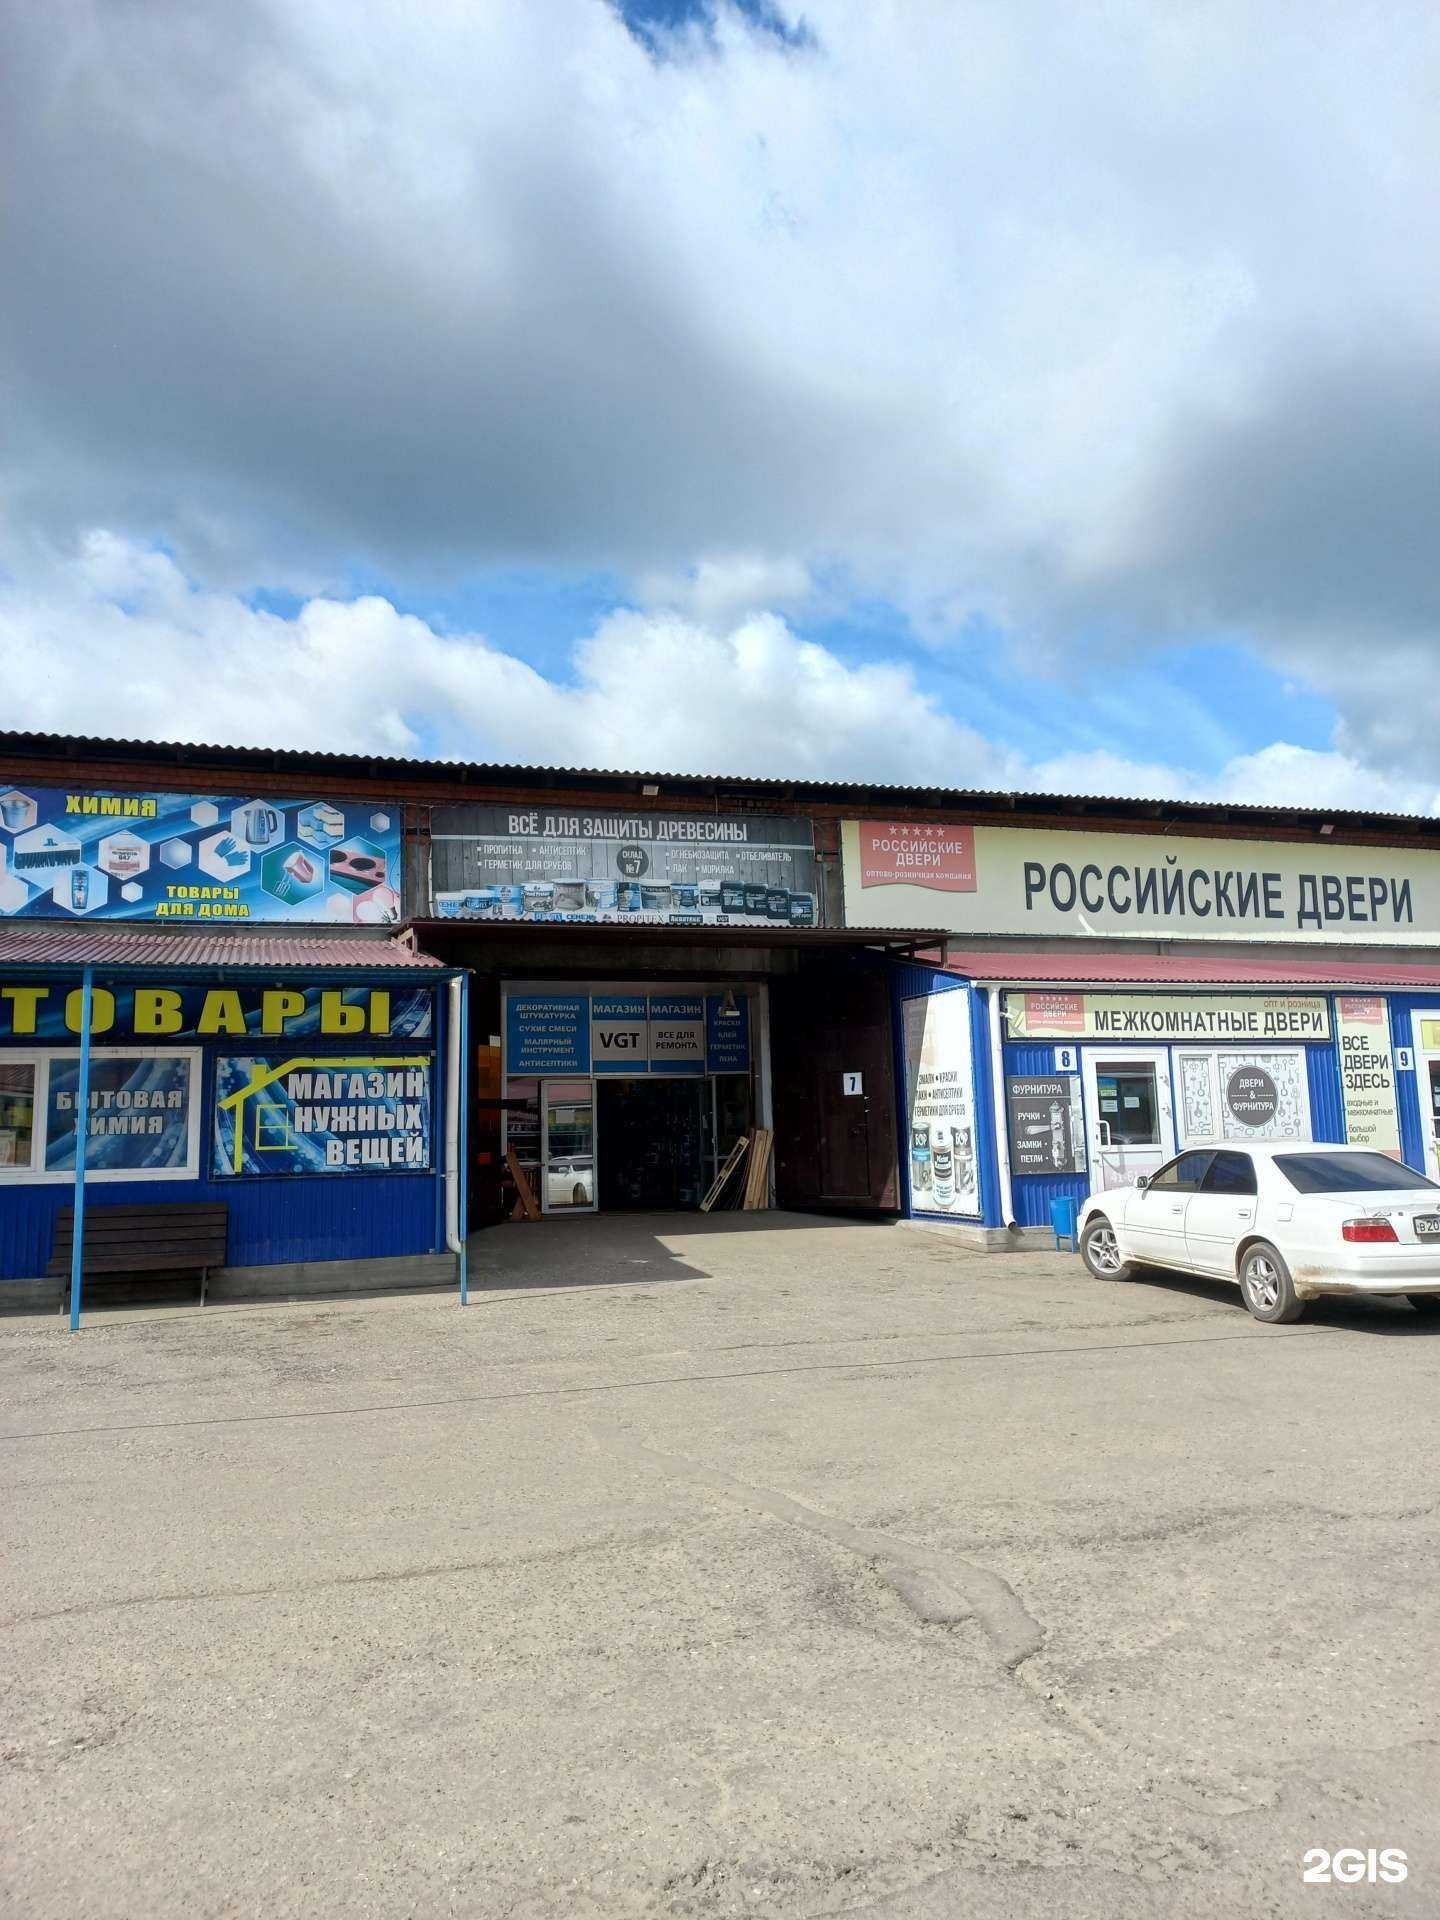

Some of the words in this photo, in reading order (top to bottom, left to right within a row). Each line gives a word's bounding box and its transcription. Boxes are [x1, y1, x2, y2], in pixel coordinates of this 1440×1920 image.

[65, 795, 157, 817] ХИМИЯ
[508, 812, 539, 835] ВСЁ
[542, 816, 580, 837] ДЛЯ
[583, 818, 653, 838] ЗАЩИТЫ
[656, 820, 748, 841] ДРЕВЕСИНЫ
[483, 844, 523, 855] ПРОПИТКА
[539, 845, 586, 856] АНТИСЕПТИК
[872, 838, 963, 854] РОССИЙСКИЕ
[622, 850, 643, 859] СКЛАД
[671, 850, 729, 860] ОГНЕБИОЗАЩИТА
[741, 851, 792, 862] ОТБЕЛИВАТЕЛЬ
[896, 852, 941, 867] ДВЕРИ
[484, 859, 523, 870] ГЕРМЕТИК
[524, 860, 542, 870] ДЛЯ
[543, 860, 571, 870] СРУБОВ
[673, 863, 688, 873] ЛАК
[166, 885, 240, 900] ТОВАРЫ
[1023, 855, 1285, 918] РОССИЙСКИЕ
[1297, 873, 1414, 929] ДВЕРИ
[155, 902, 195, 916] ДЛЯ
[197, 903, 250, 917] ДОМА
[1, 987, 391, 1034] ТОВАРЫ
[515, 1004, 580, 1012] ДЕКОРАТИВНАЯ
[593, 1004, 646, 1014] МАГАЗИН
[650, 1005, 702, 1014] МАГАЗИН
[1031, 1001, 1079, 1011] РОССИЙСКИЕ
[1264, 1000, 1277, 1009] опт
[1280, 1001, 1286, 1009] и
[1288, 1001, 1321, 1010] розница
[519, 1012, 577, 1020] ШТУКАТУРКА
[1044, 1010, 1067, 1018] ДВЕРИ
[1094, 1009, 1259, 1032] МЕЖКОМНАТНЫЕ
[1263, 1011, 1323, 1035] ДВЕРИ
[599, 1032, 641, 1049] VGT
[657, 1031, 674, 1039] ВСЕ
[676, 1031, 695, 1040] ДЛЯ
[524, 1038, 574, 1046] МАЛЯРНЫЙ
[655, 1041, 698, 1050] РЕМОНТА
[1341, 1035, 1370, 1051] ВСЕ
[520, 1046, 575, 1055] ИНСТРУМЕНТ
[518, 1060, 578, 1068] АНТИСЕПТИКИ
[1061, 1050, 1071, 1068] 8
[1343, 1054, 1389, 1074] ДВЕРИ
[1399, 1050, 1410, 1067] 9
[287, 1071, 426, 1100] МАГАЗИН
[849, 1076, 856, 1092] 7
[1239, 1078, 1264, 1089] ДВЕРИ
[1345, 1073, 1391, 1093] ЗДЕСЬ
[1012, 1084, 1063, 1095] ФУРНИТУРА
[1249, 1090, 1257, 1099] &
[1232, 1101, 1275, 1111] ФУРНИТУРА
[293, 1102, 423, 1133] НУЖНЫХ
[1017, 1112, 1041, 1121] РУЧКИ
[1348, 1124, 1377, 1133] большой
[325, 1131, 424, 1168] ВЕЩЕЙ
[1016, 1140, 1043, 1150] ЗАМКИ
[1020, 1154, 1044, 1164] ПЕТЛИ
